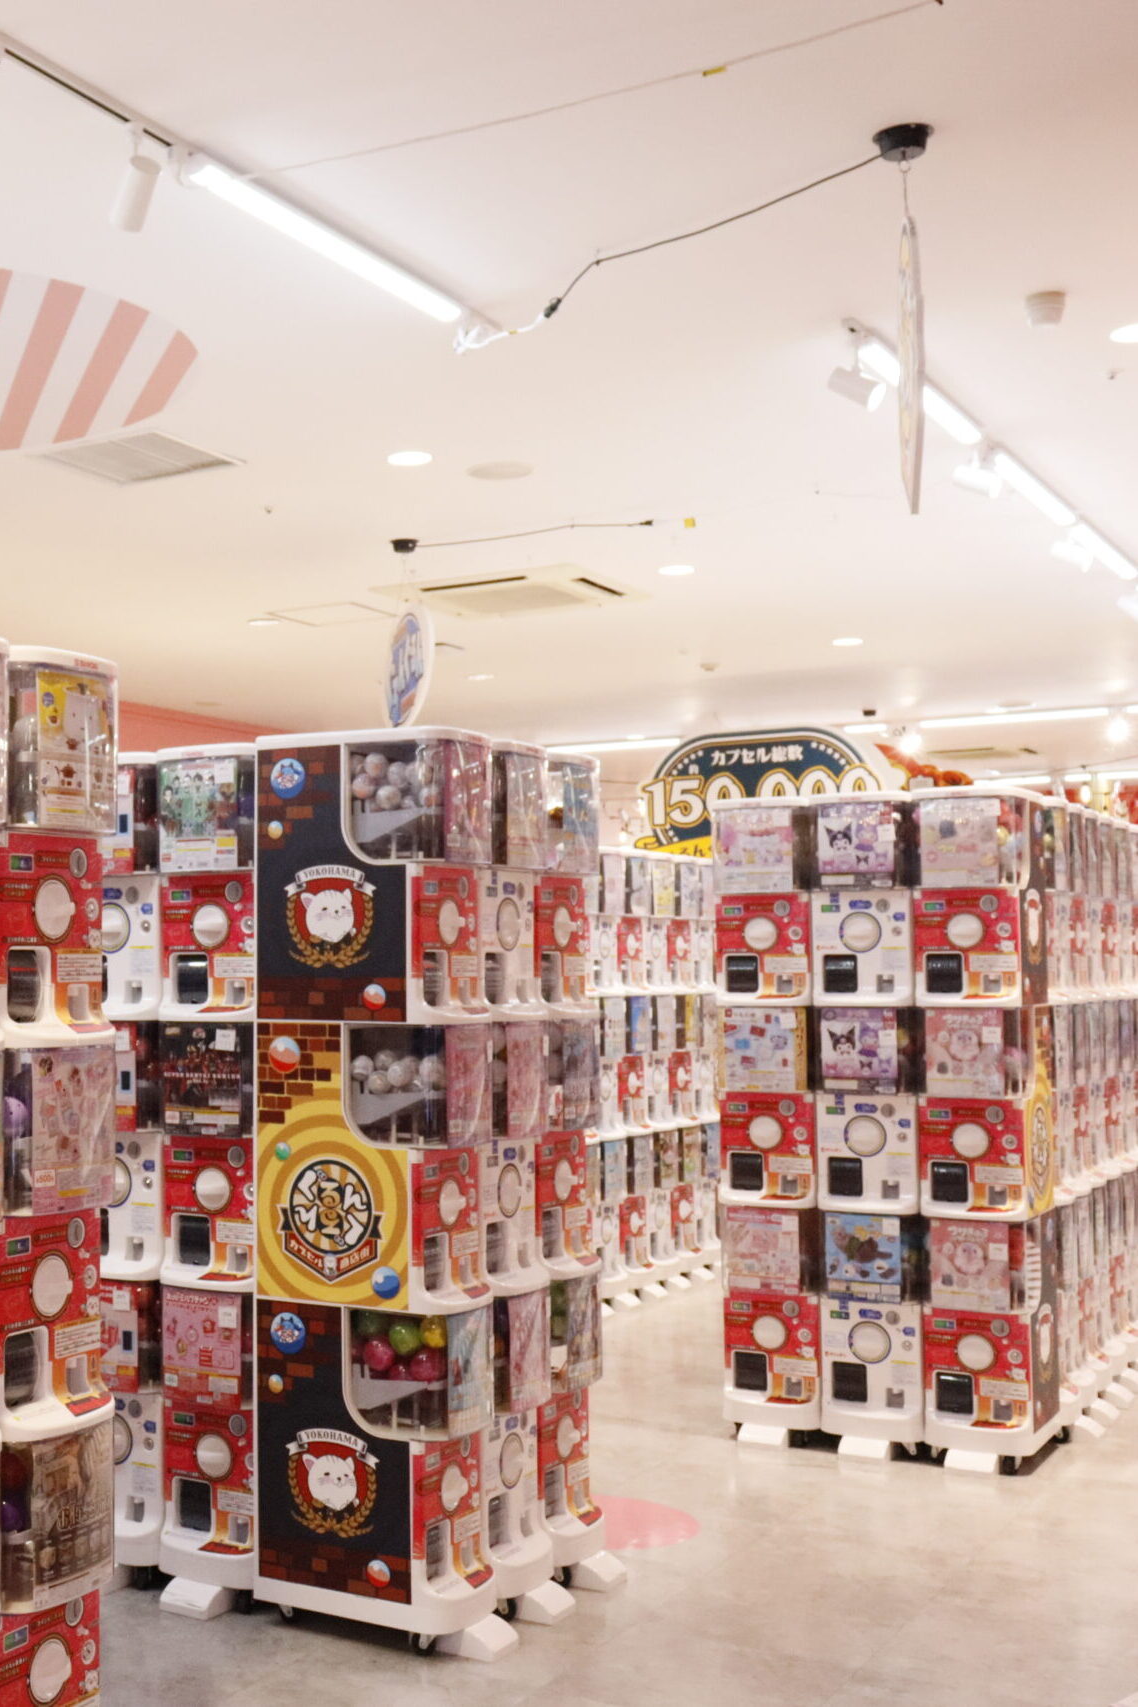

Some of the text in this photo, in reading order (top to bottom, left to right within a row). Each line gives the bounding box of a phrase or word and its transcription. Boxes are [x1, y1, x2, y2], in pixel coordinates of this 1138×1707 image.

[711, 744, 804, 766] カプセル総数
[304, 867, 356, 879] YOKOHAMA
[289, 1239, 324, 1268] カプセル
